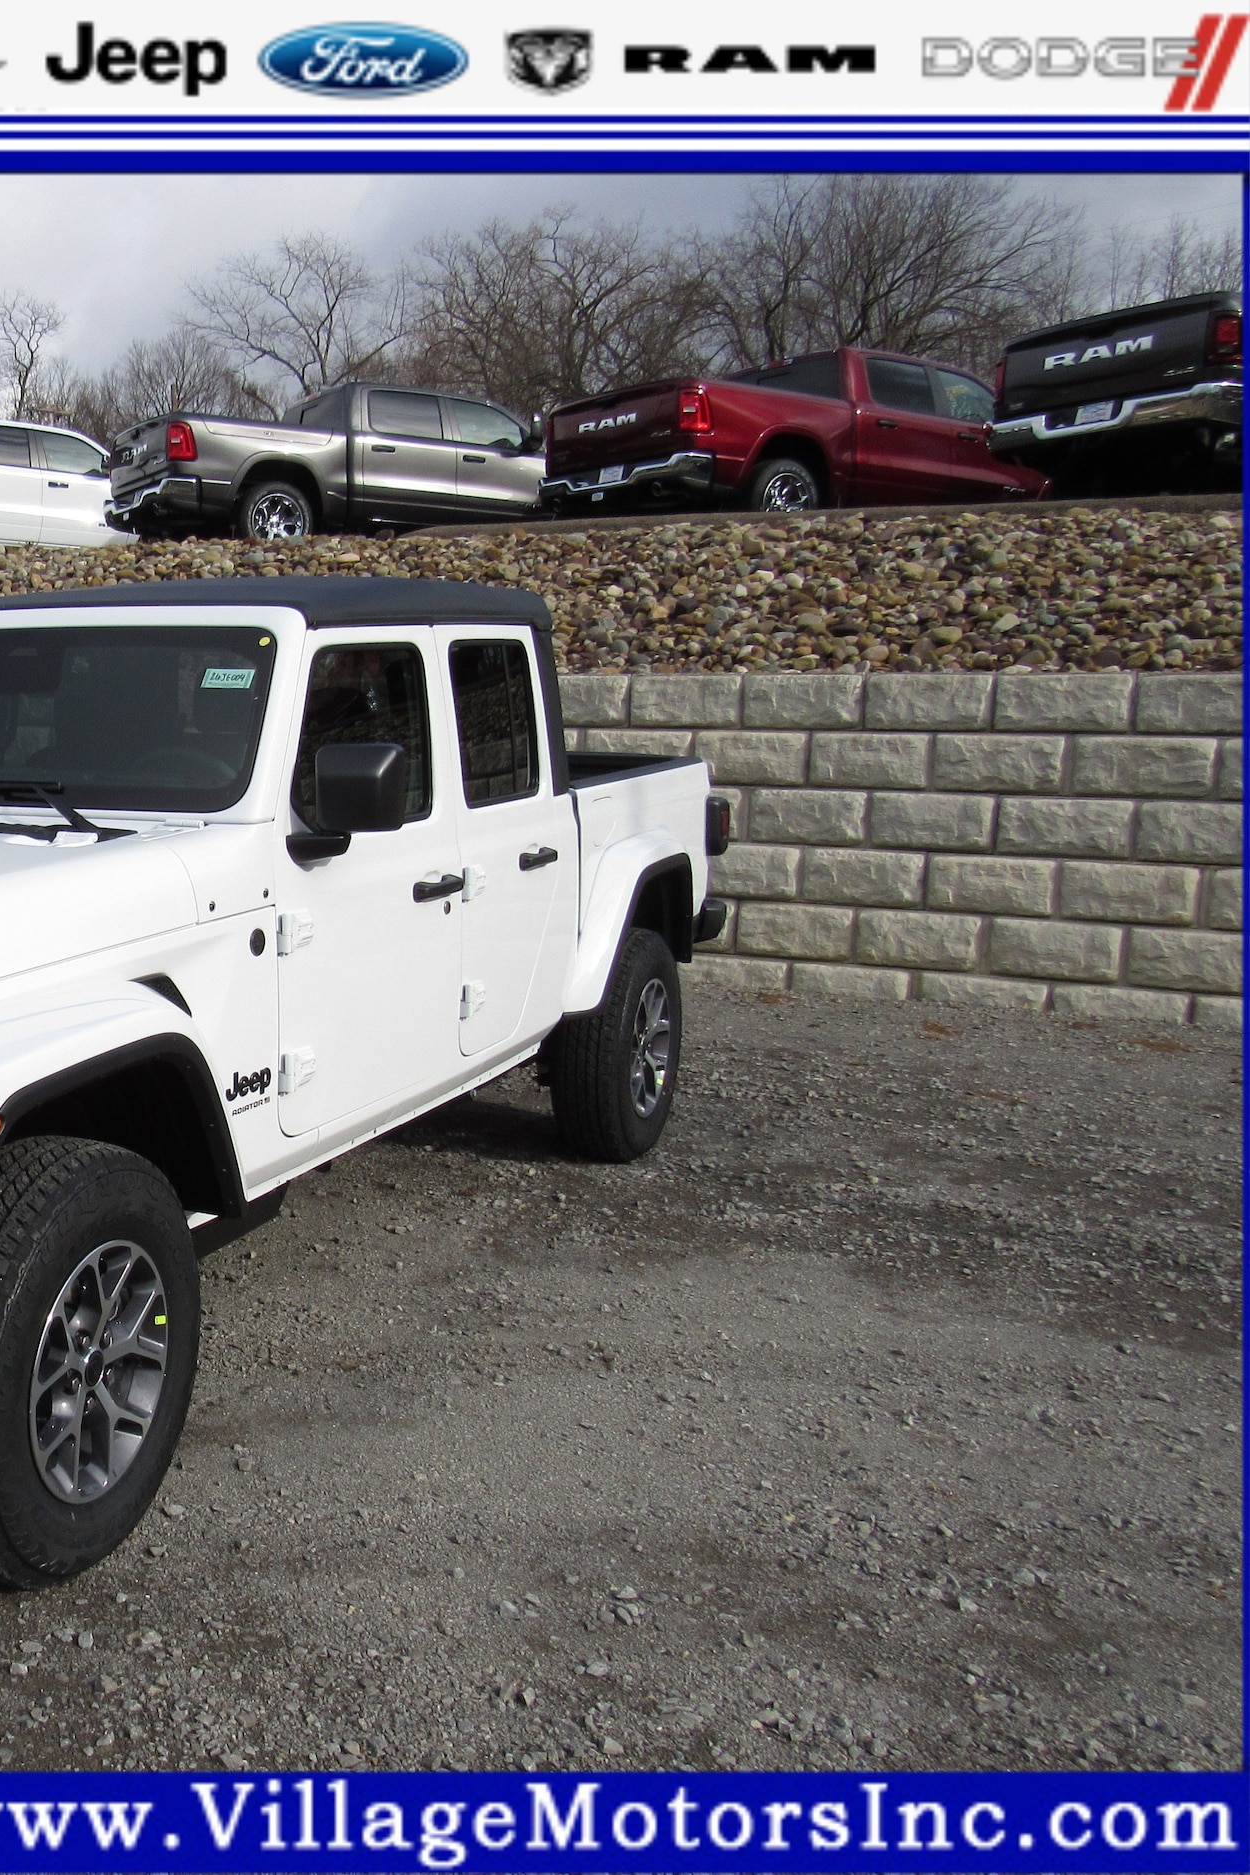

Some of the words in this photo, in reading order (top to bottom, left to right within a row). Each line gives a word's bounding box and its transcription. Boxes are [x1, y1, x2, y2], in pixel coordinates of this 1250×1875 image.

[1043, 335, 1154, 370] RAM
[578, 412, 637, 434] RAM
[225, 1067, 272, 1101] Jeep
